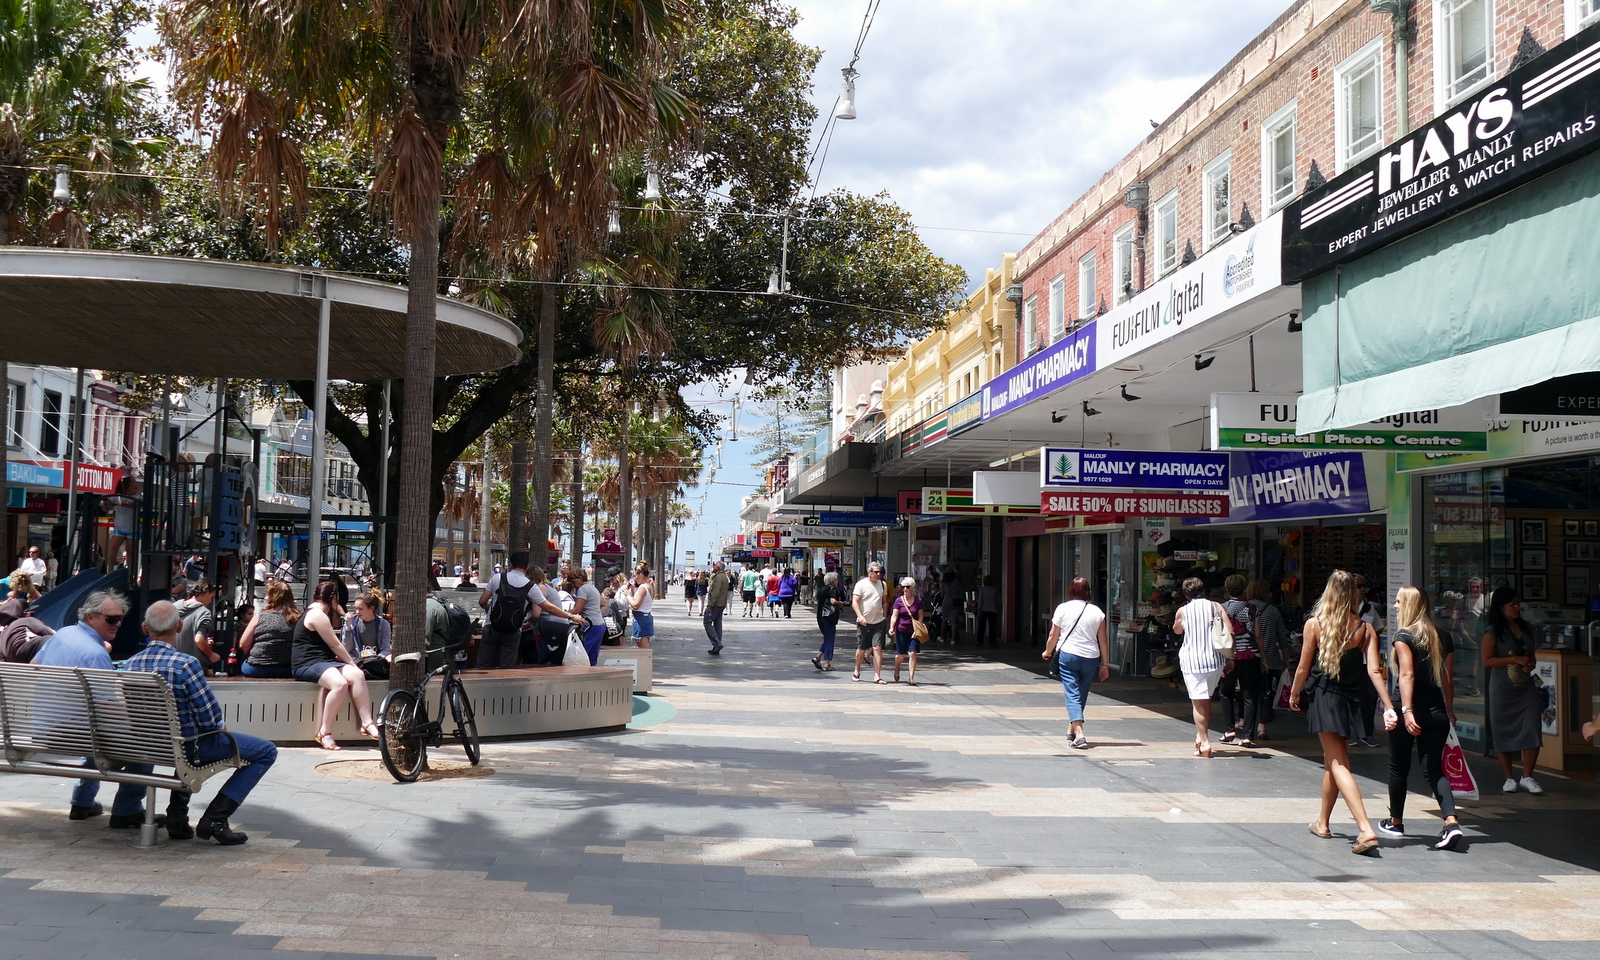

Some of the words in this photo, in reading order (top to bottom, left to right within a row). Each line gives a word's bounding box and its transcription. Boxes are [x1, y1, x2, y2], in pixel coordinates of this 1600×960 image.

[1379, 87, 1513, 195] HAYS
[1377, 166, 1450, 213] JEWELLER
[1458, 130, 1515, 173] MANLY
[1328, 225, 1368, 254] EXPERT
[1371, 190, 1443, 233] JEWELLERY
[1449, 184, 1459, 197] &
[1464, 155, 1515, 189] WATCH
[1522, 115, 1596, 161] REPAIRS
[1112, 301, 1160, 350] FUJIFILM
[1163, 272, 1204, 326] digital
[991, 391, 1007, 412] MALOUF
[1009, 366, 1036, 403] MANLY
[1036, 335, 1089, 389] PHARMACY
[1557, 396, 1600, 409] EXPE
[1245, 432, 1316, 445] Digital
[1324, 434, 1386, 445] Photo
[1394, 434, 1462, 446] Centre
[1550, 436, 1567, 446] picture
[1574, 433, 1589, 441] worth
[11, 464, 37, 483] BAKU
[1083, 460, 1136, 475] MANLY
[1139, 462, 1226, 477] PHARMACY
[103, 471, 113, 490] ON
[1252, 460, 1350, 505] PHARMACY
[928, 497, 943, 506] 24
[1049, 496, 1080, 512] SALE
[1082, 497, 1112, 513] 50%
[1114, 498, 1137, 513] OFF
[1139, 498, 1222, 514] SUNGLASSES
[795, 527, 852, 537] sussan
